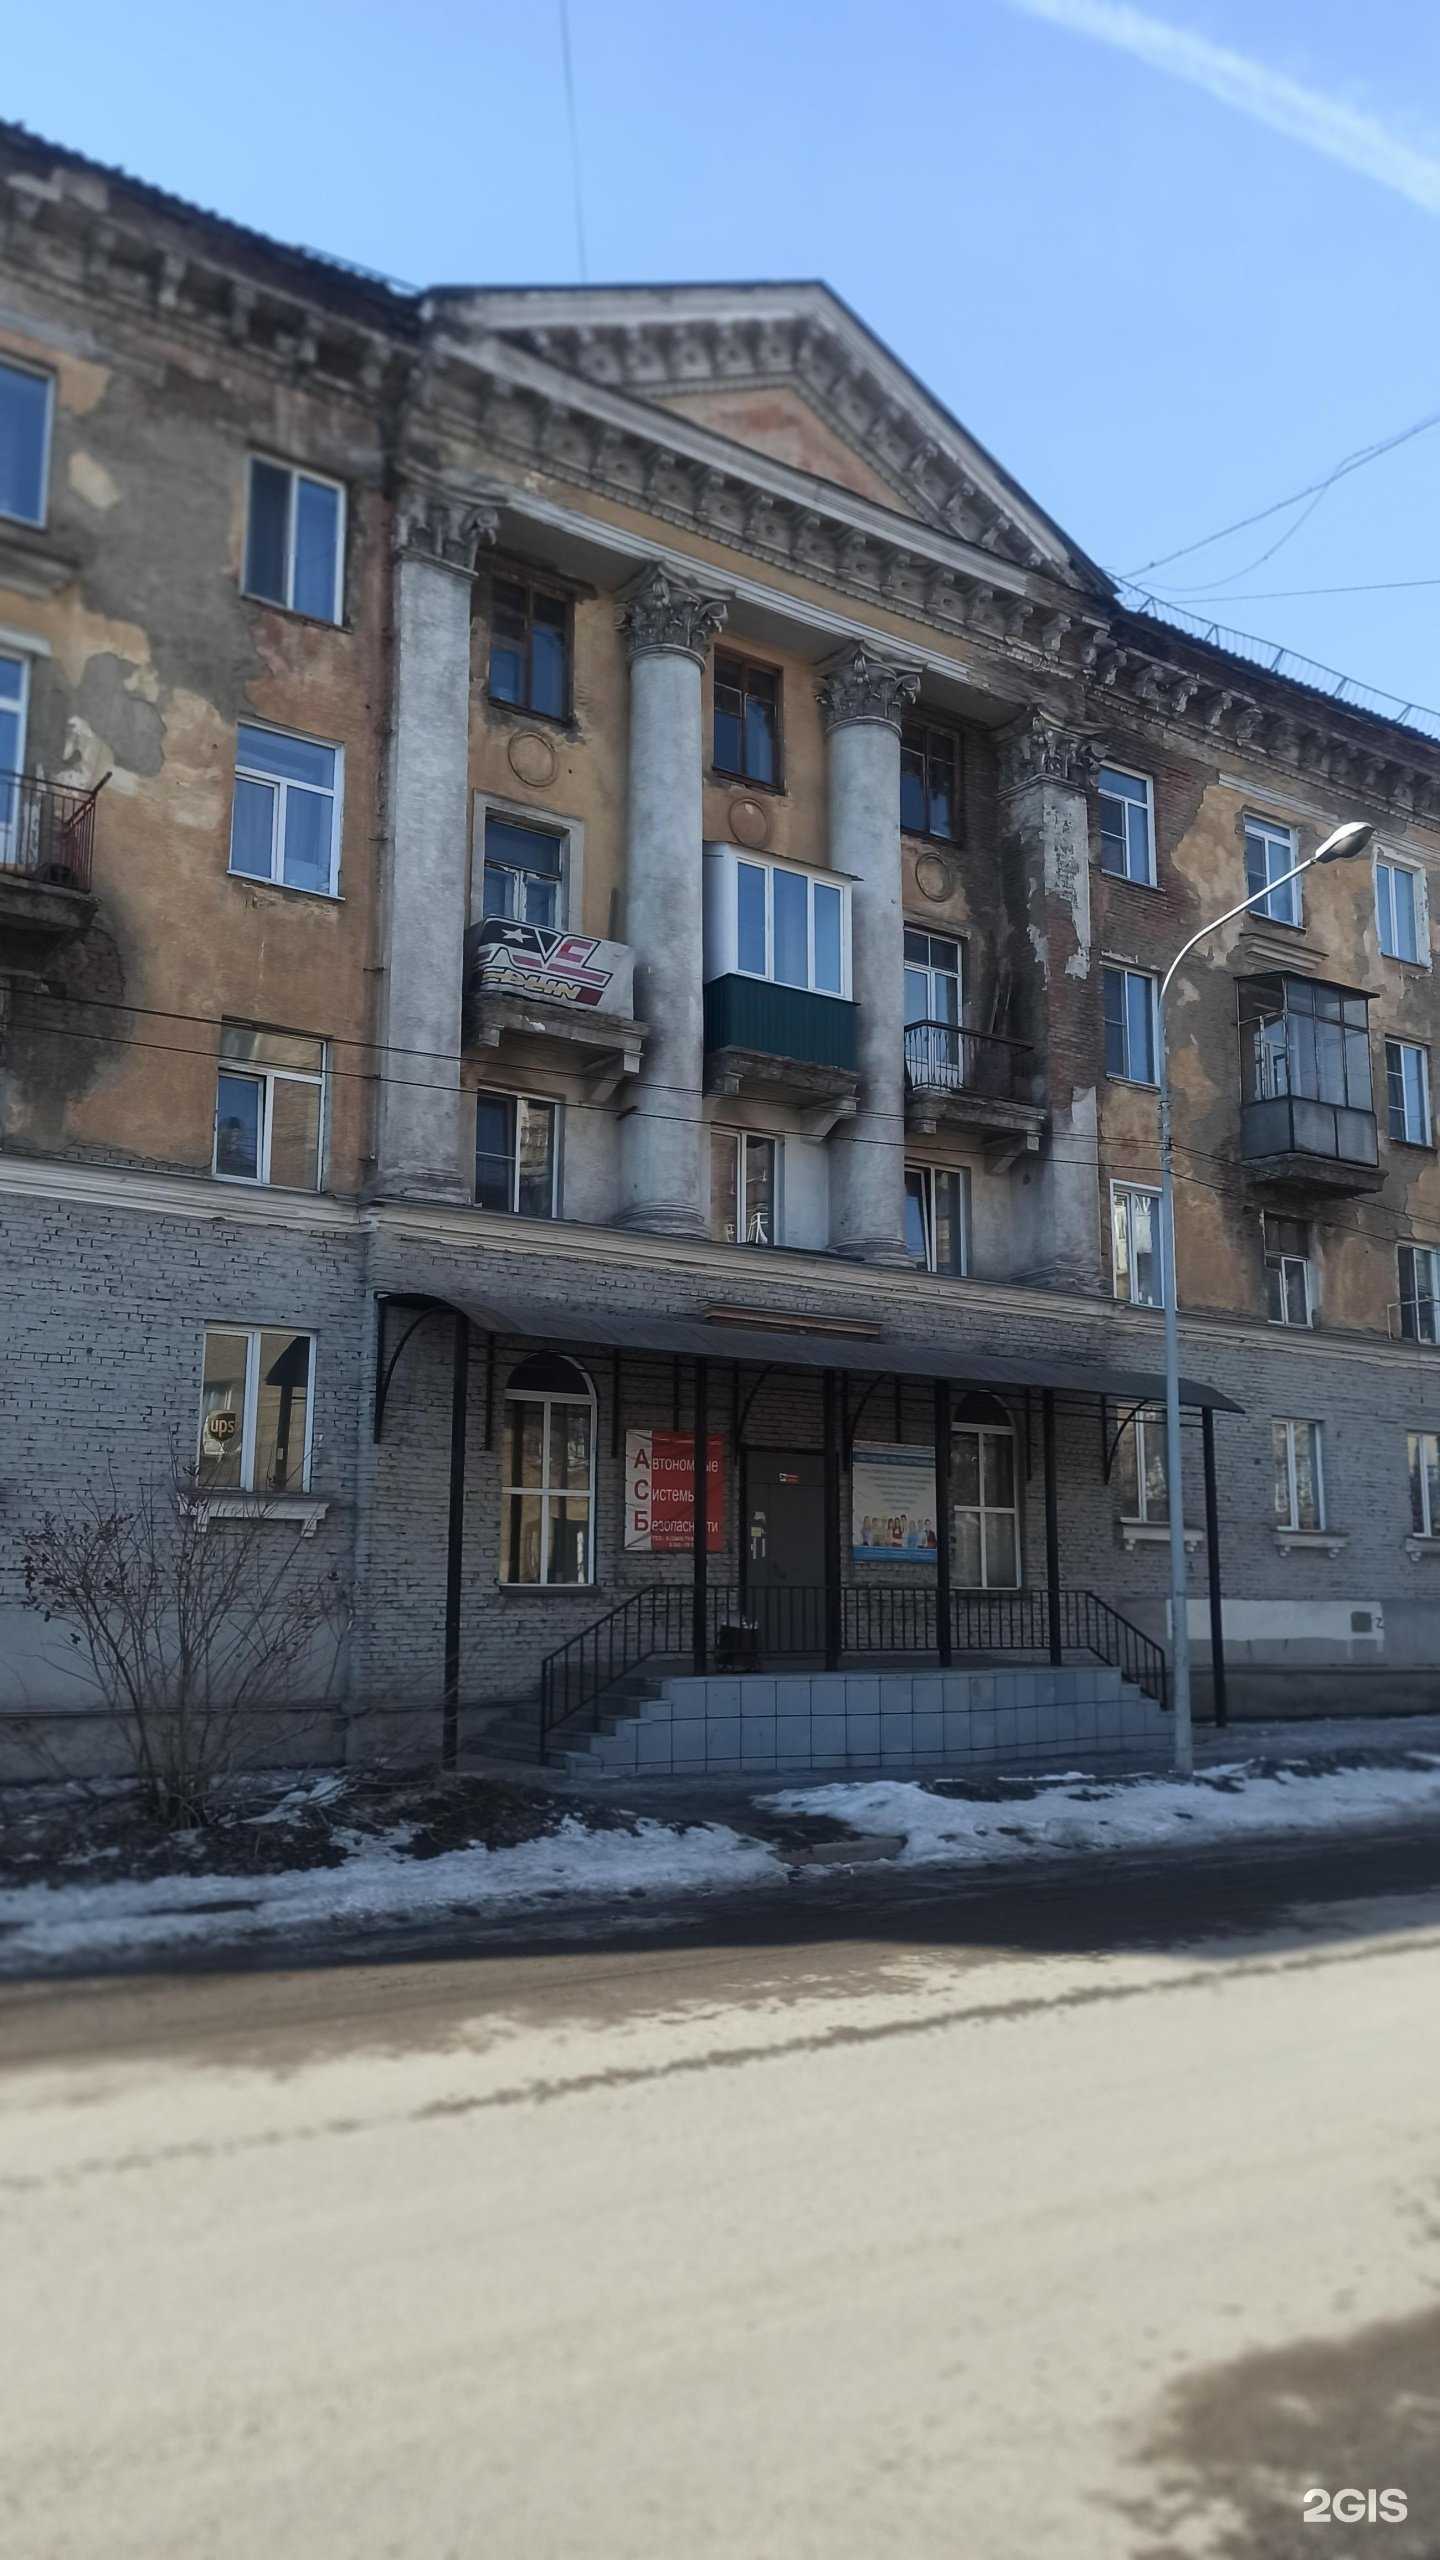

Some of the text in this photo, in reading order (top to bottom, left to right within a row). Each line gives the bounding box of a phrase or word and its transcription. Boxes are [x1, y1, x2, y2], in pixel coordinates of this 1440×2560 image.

[210, 1419, 235, 1438] ups
[634, 1448, 719, 1473] Автономе
[635, 1510, 719, 1533] Безопаснти
